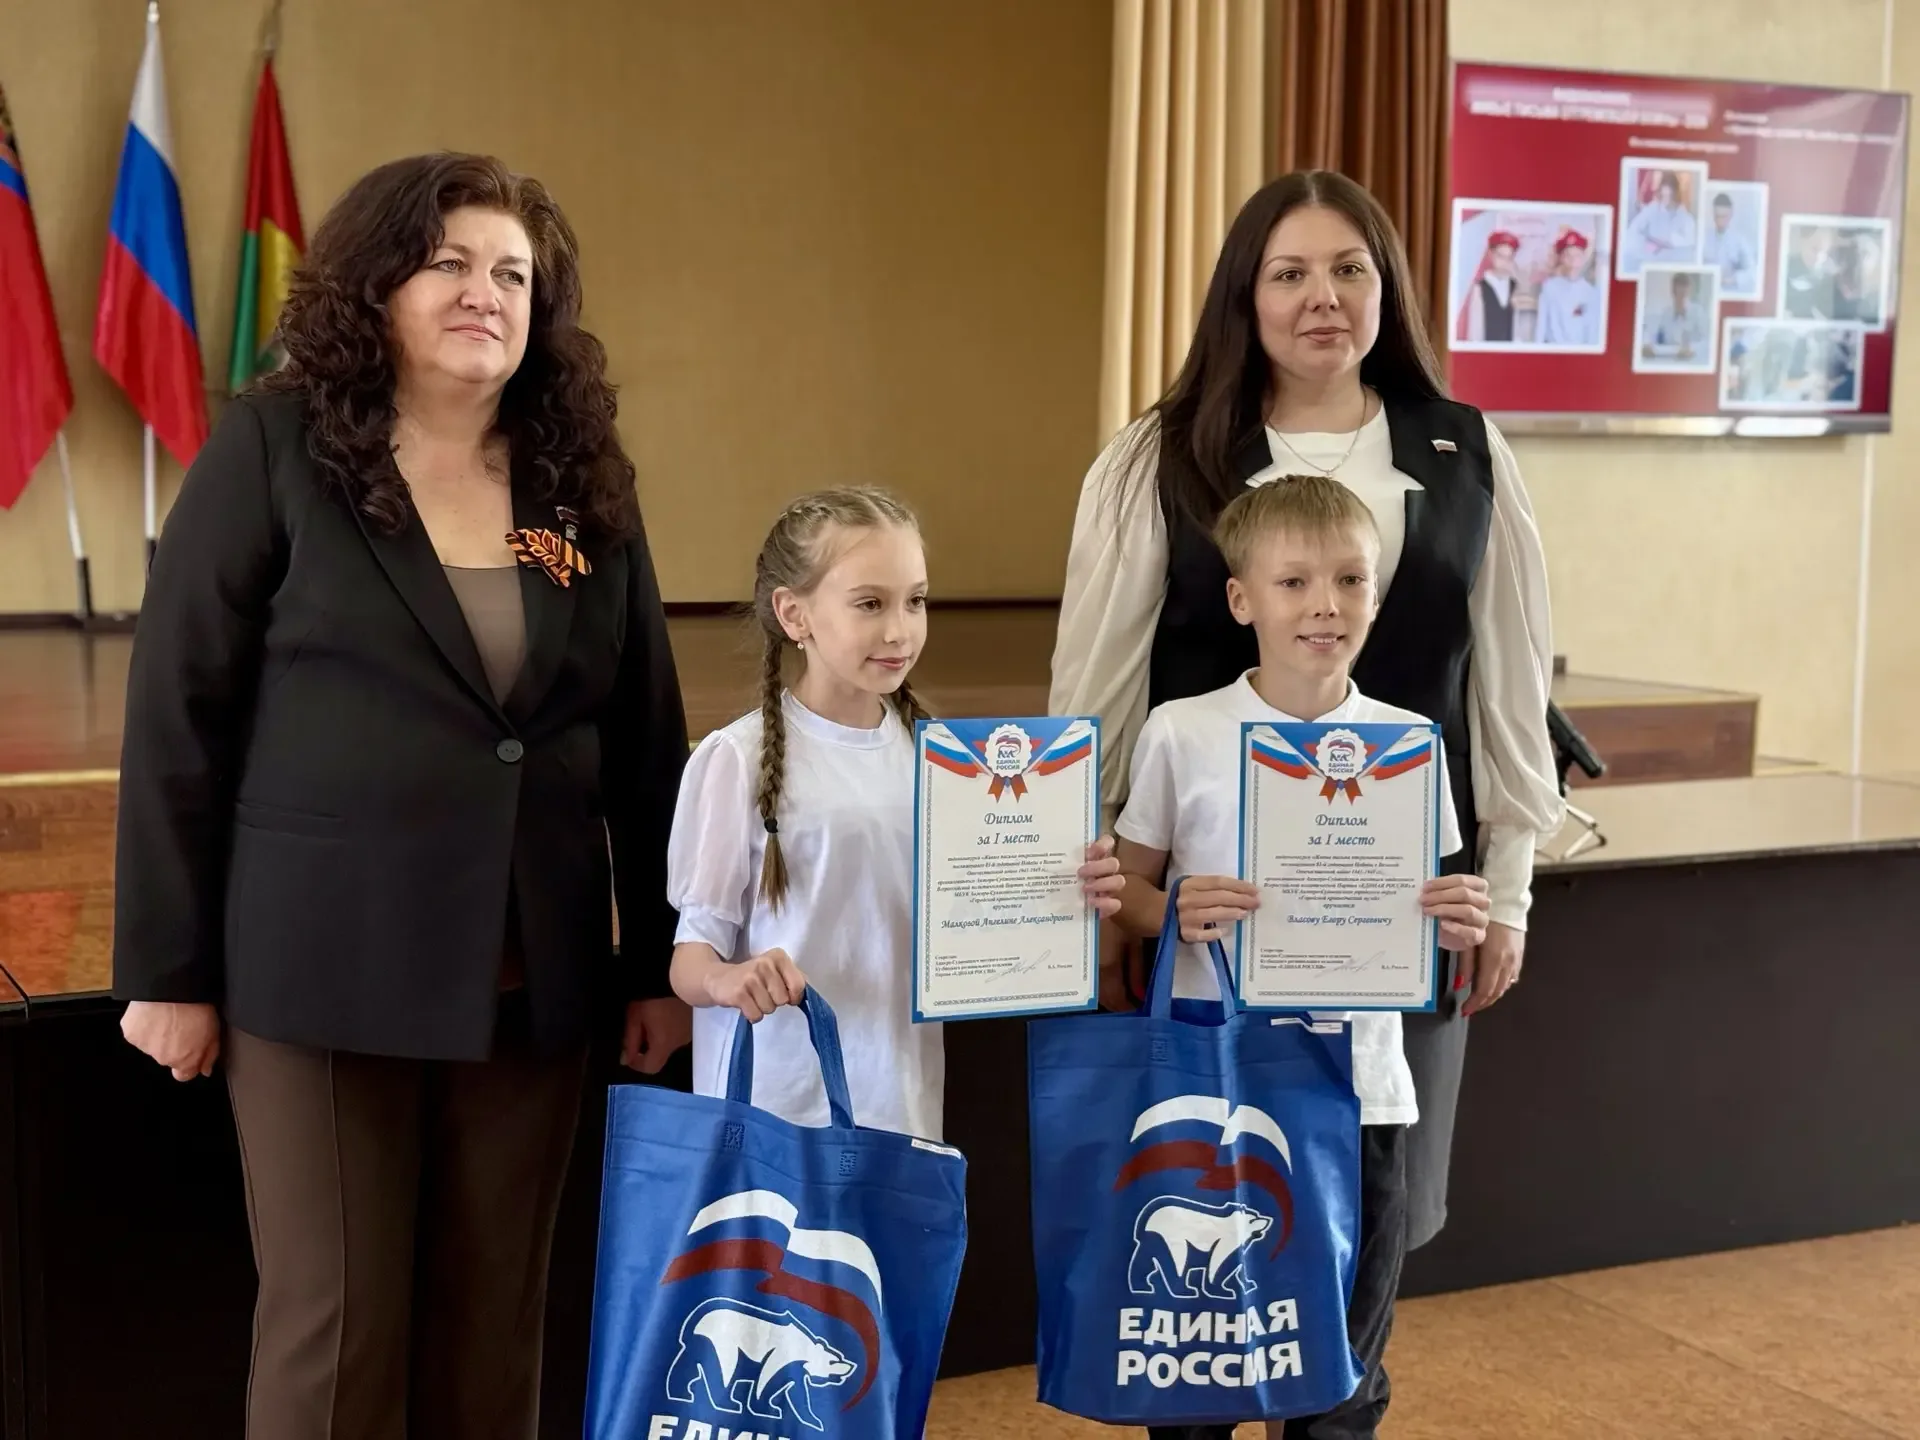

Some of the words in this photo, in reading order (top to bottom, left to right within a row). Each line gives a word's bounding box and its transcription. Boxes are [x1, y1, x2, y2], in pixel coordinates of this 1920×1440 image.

[984, 812, 1033, 825] Диплом
[1315, 813, 1368, 826] Диплом
[977, 836, 990, 845] за
[1002, 833, 1040, 844] место
[1307, 835, 1322, 845] за
[1334, 835, 1375, 846] место
[1119, 1298, 1299, 1348] ЕДИНАЯ
[1116, 1340, 1304, 1388] РОССИЯ
